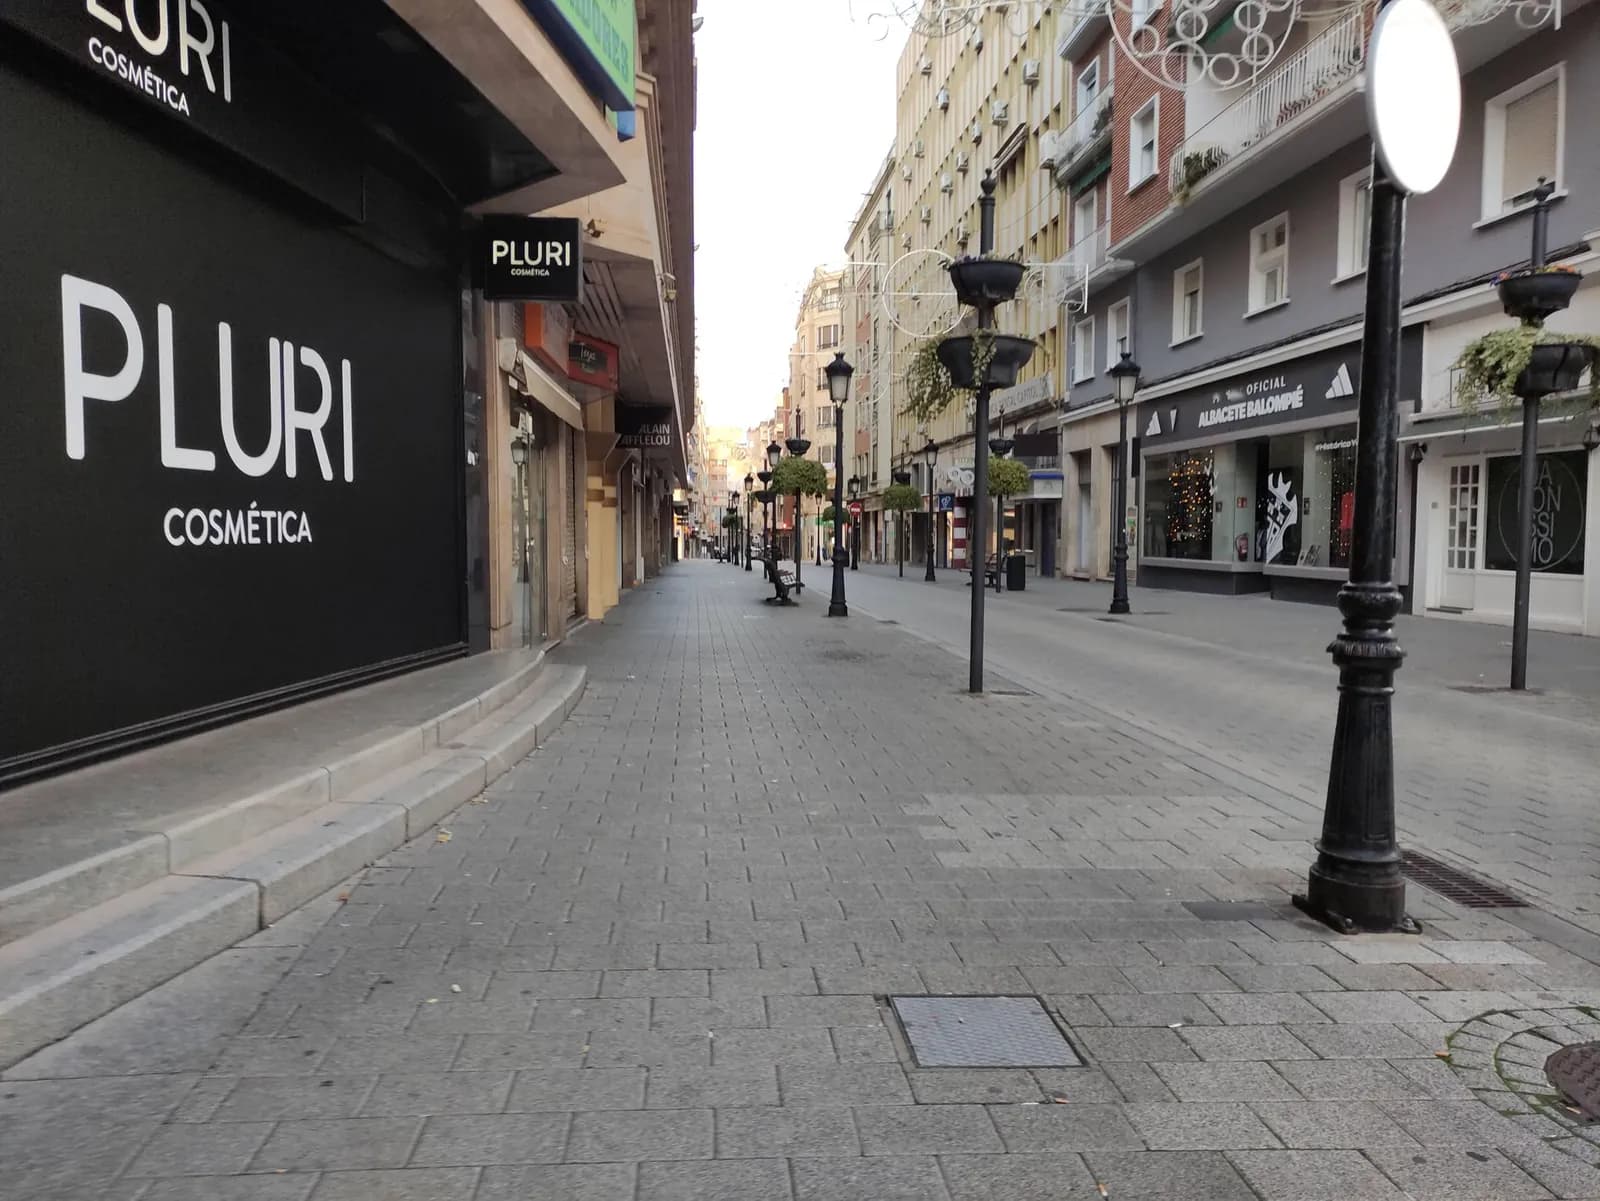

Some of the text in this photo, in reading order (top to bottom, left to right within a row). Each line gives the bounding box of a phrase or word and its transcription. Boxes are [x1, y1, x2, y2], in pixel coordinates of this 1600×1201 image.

[88, 37, 190, 117] COSMÉTICA
[492, 240, 570, 266] PLURI
[511, 268, 549, 276] COSMÉTICA
[61, 273, 354, 483] PLURI
[1246, 375, 1287, 396] OFICIAL
[1198, 402, 1247, 429] ALBACETE
[1247, 384, 1304, 418] BALOMPIÉ
[639, 423, 670, 434] ALAIN
[1517, 485, 1561, 513] ON
[163, 501, 313, 546] COSMÉTICA
